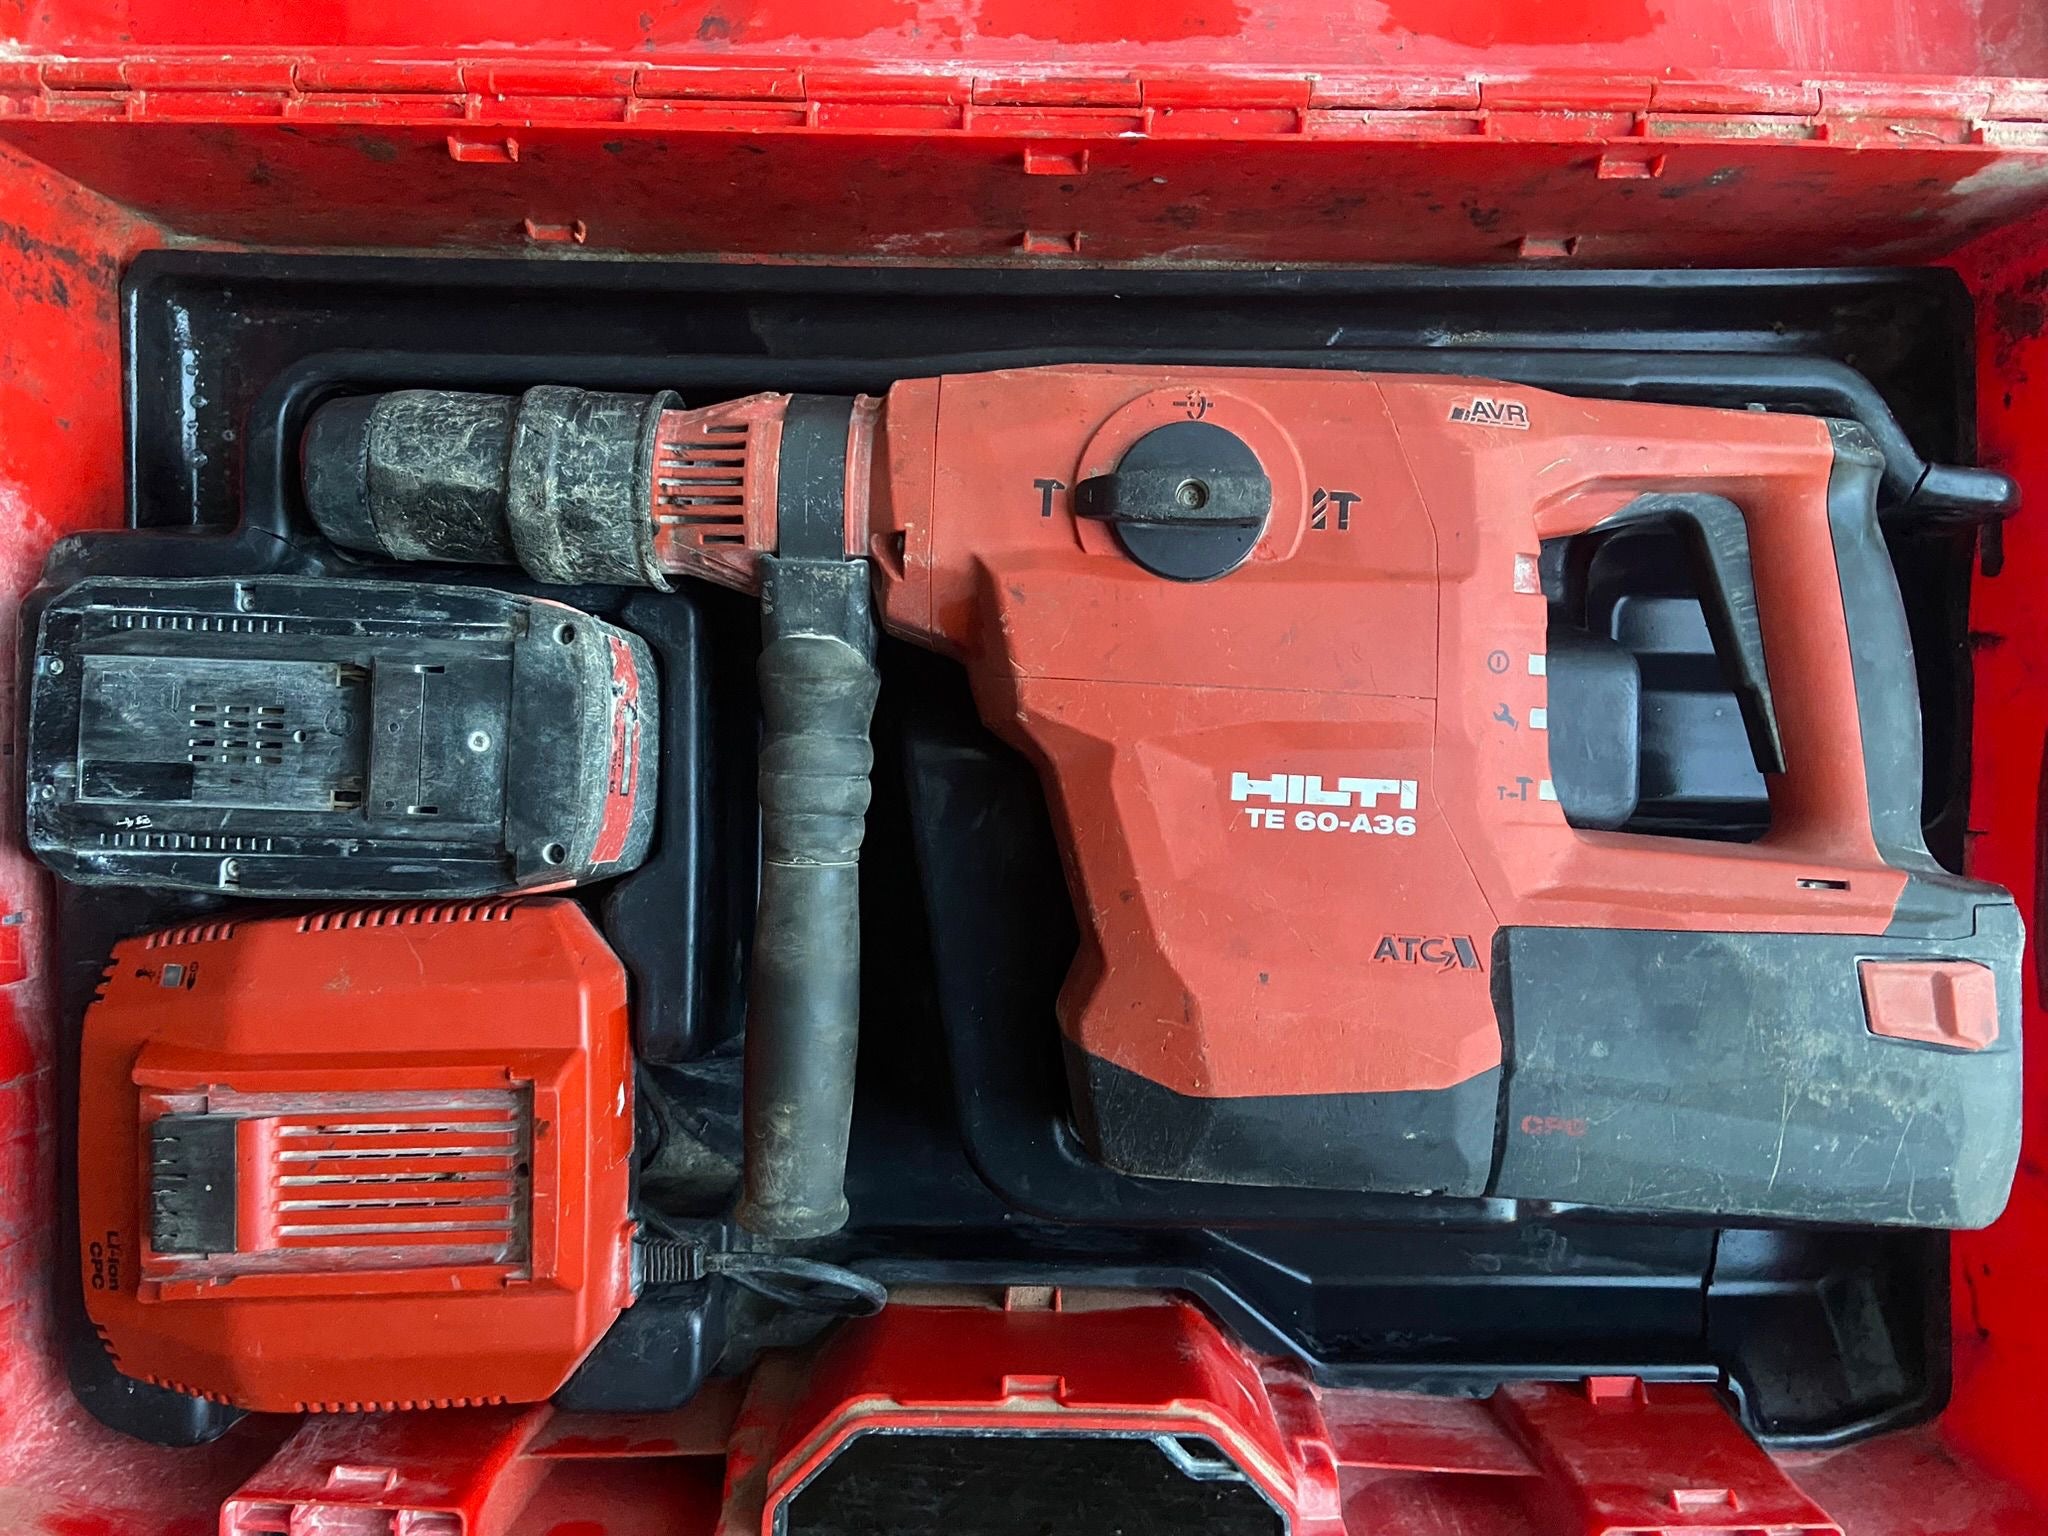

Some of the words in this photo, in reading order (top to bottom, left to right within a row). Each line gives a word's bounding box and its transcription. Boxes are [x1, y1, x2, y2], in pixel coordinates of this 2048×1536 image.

[1472, 400, 1526, 423] AVR
[1231, 772, 1418, 810] HILTI
[1244, 807, 1286, 830] TE
[1294, 810, 1417, 837] 60-A36
[89, 1241, 105, 1290] CPC
